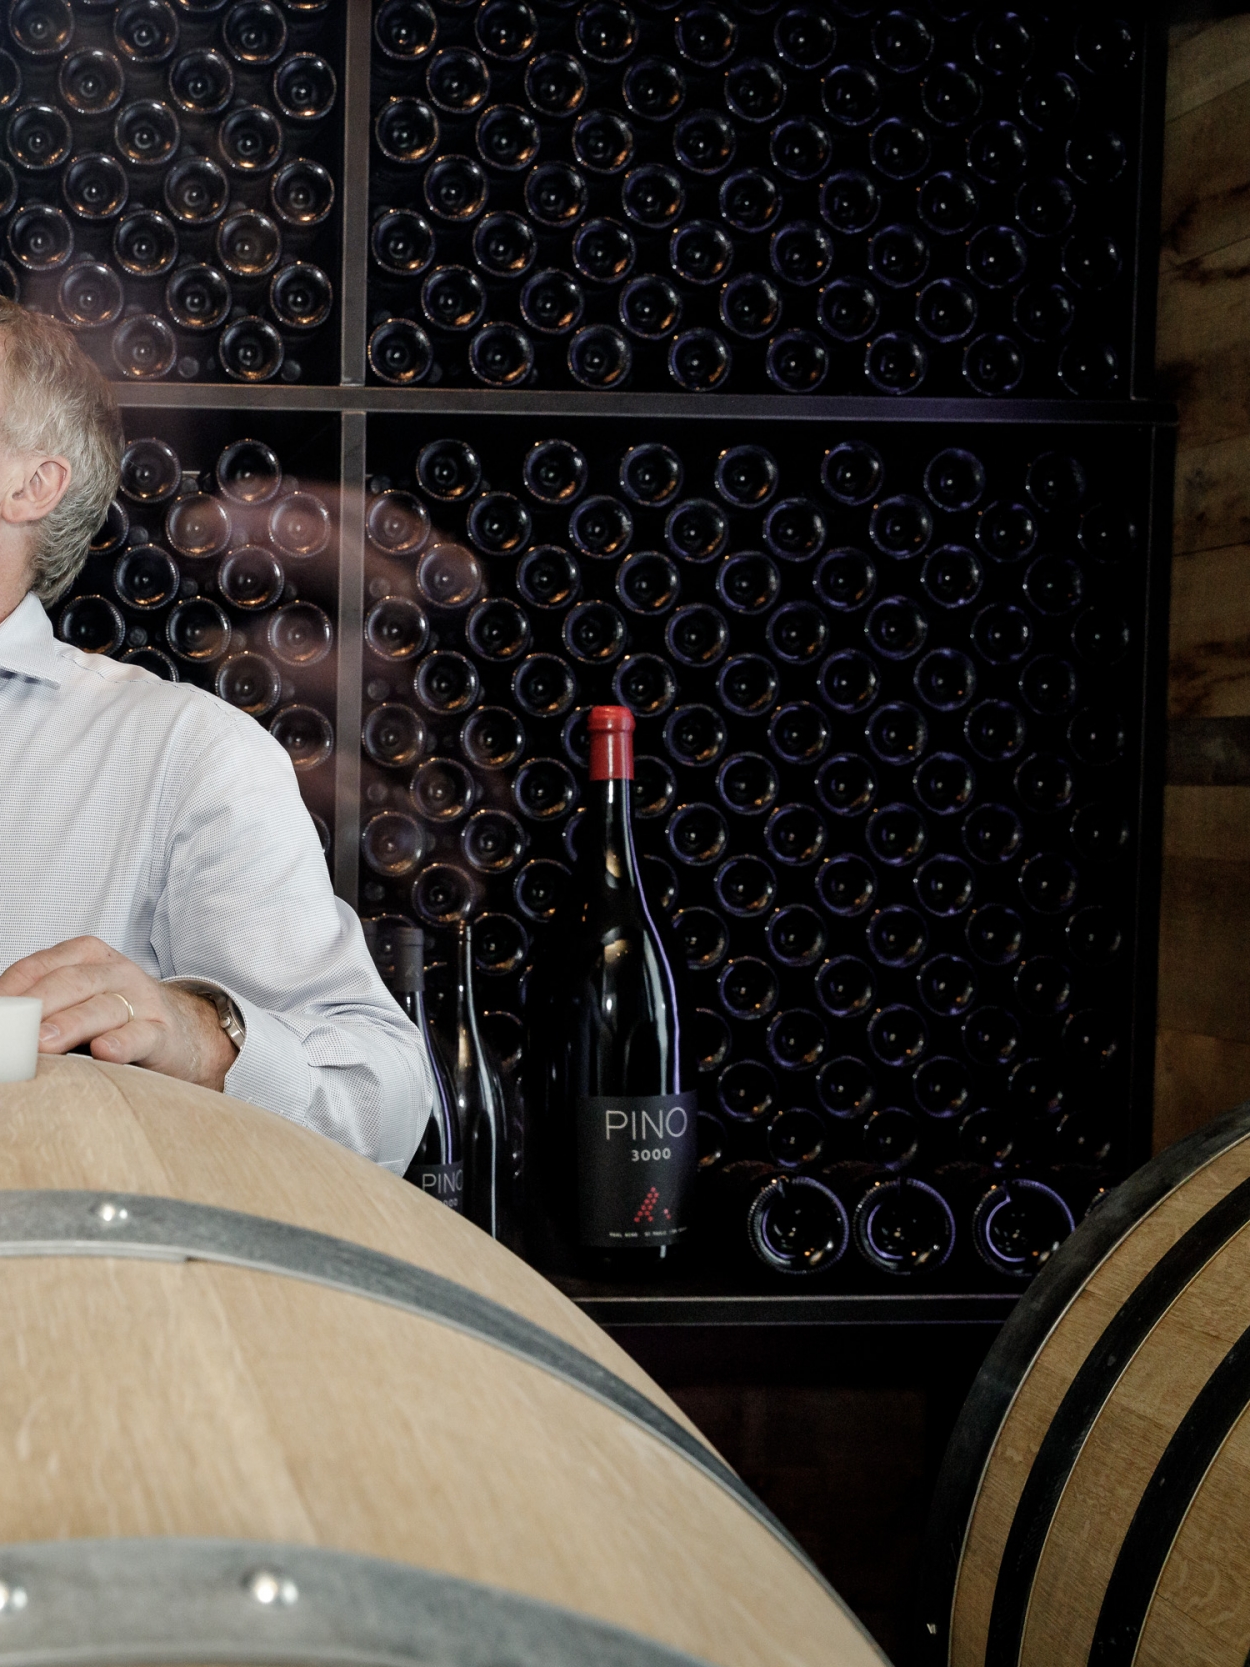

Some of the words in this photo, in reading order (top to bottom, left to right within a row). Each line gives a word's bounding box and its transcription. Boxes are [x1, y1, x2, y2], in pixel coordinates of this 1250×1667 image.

[605, 1106, 689, 1141] PINO
[631, 1147, 672, 1162] 3000
[422, 1168, 464, 1195] PINO
